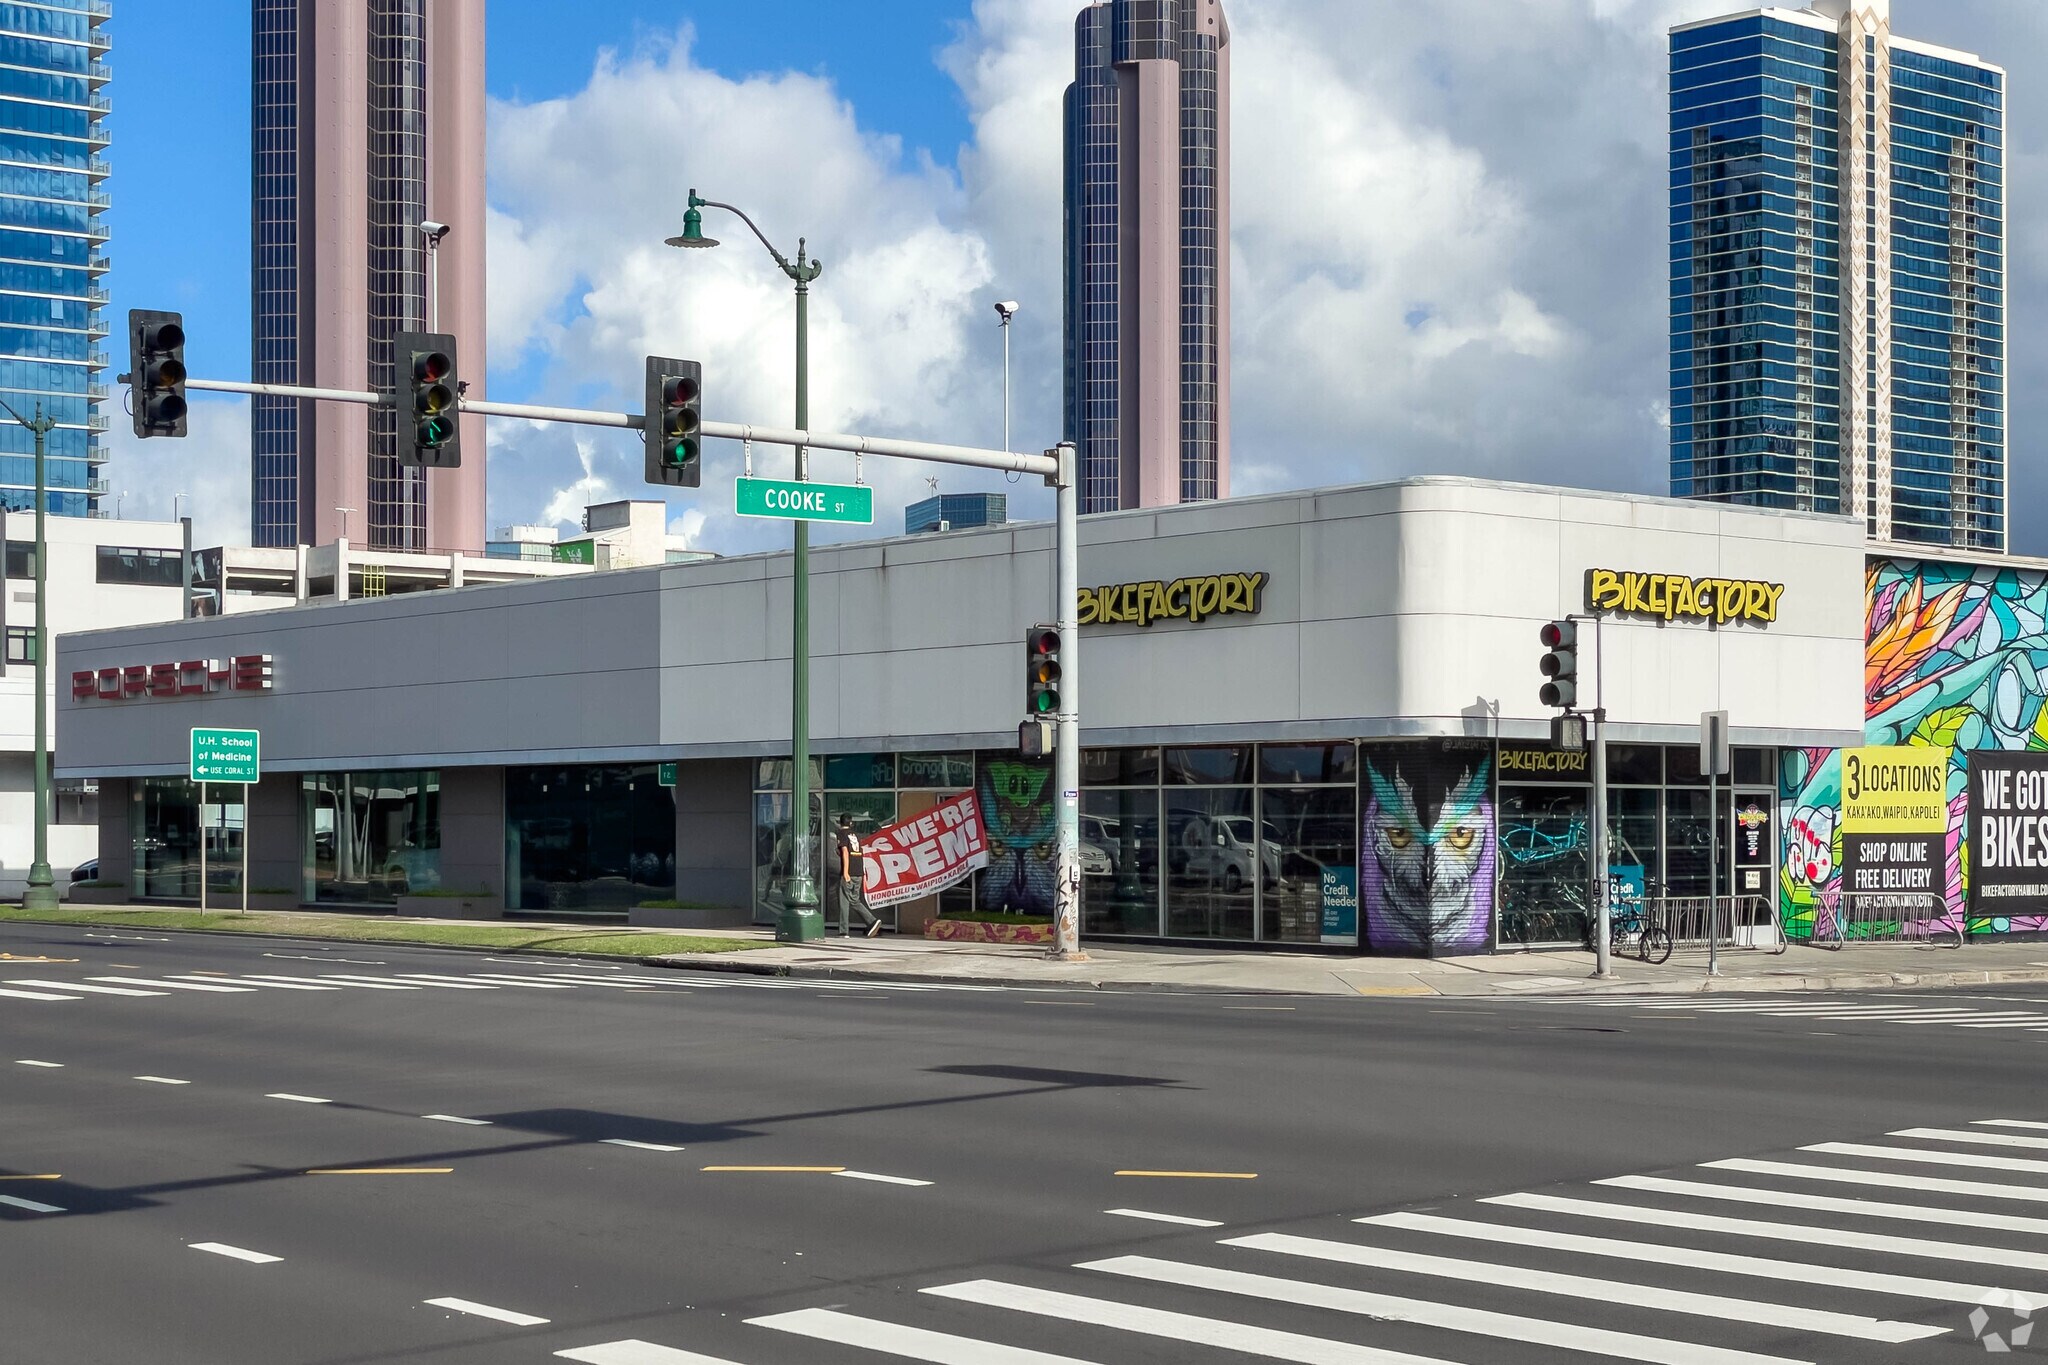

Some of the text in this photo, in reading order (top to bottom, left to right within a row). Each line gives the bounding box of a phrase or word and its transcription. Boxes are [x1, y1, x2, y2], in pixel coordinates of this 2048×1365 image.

[764, 488, 845, 513] COOKE ST
[1077, 572, 1264, 627] BIKEFACTORY
[1590, 569, 1784, 624] BIKEFACTORY
[71, 654, 273, 702] PORSCHE
[198, 736, 253, 747] U.H. School
[198, 753, 252, 762] of Medicine
[1499, 751, 1588, 772] BIKEFACTORY
[210, 766, 254, 776] USE CORAL ST
[1847, 755, 1941, 800] 3 LOCATIONS
[1981, 769, 2011, 810] WE
[891, 796, 975, 847] WE'RE
[1859, 842, 1928, 863] SHOP ONLINE
[1981, 815, 2048, 868] BIKES
[870, 886, 910, 901] HONOLULU
[915, 876, 943, 891] WAIPIO
[1323, 872, 1336, 884] No
[1323, 885, 1349, 895] Credit
[1855, 867, 1932, 889] FREE DELIVERY
